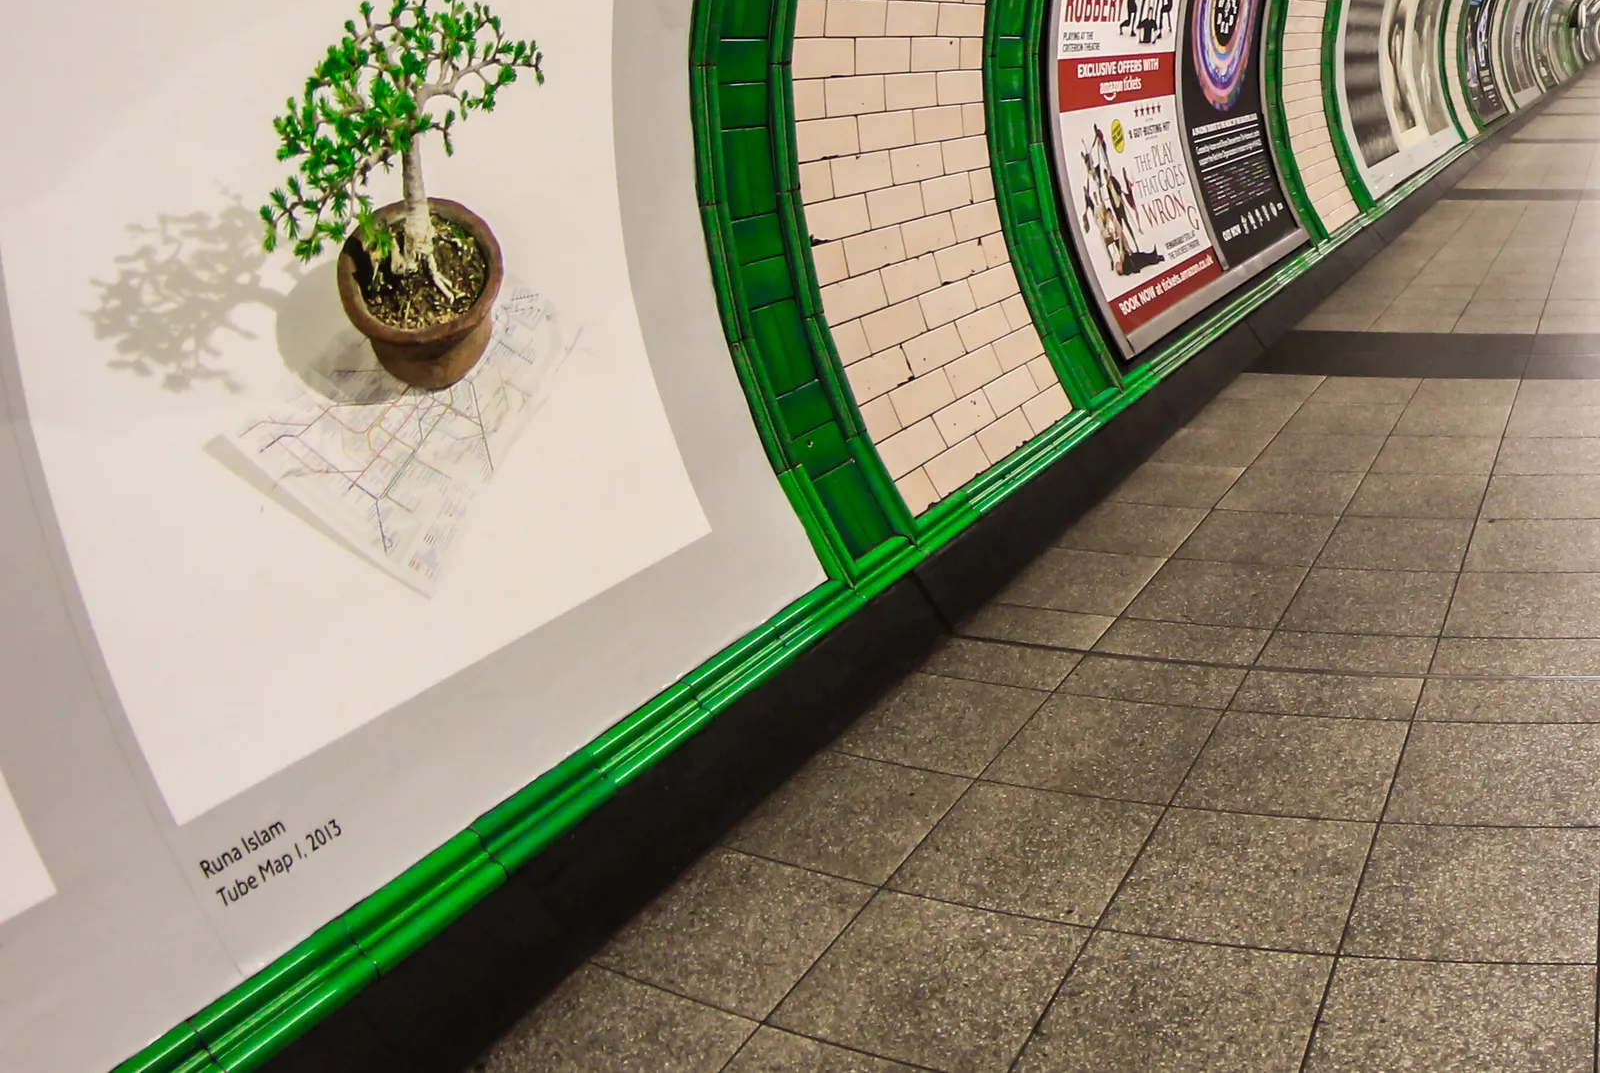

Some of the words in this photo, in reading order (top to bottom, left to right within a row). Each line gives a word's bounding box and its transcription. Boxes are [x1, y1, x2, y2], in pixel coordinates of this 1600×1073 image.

[1077, 62, 1117, 79] EXCLUSIVE
[1117, 59, 1142, 75] OFFERS
[1142, 57, 1160, 71] WITH
[1100, 79, 1123, 94] amazon
[1123, 75, 1142, 91] tickets
[1133, 123, 1163, 138] GUT-BUSTING
[1133, 154, 1152, 174] THE
[1151, 141, 1174, 168] PLAY
[1135, 175, 1159, 199] THAT
[1157, 164, 1186, 192] GOES
[1141, 190, 1200, 230] WRONG
[1118, 295, 1142, 316] BOOK
[1138, 286, 1157, 305] NOW
[1155, 283, 1164, 296] at
[1161, 254, 1214, 292] tickets.amazon.co.uk
[199, 847, 243, 879] Runa
[241, 821, 287, 854] Islam
[216, 875, 259, 907] Tube
[258, 853, 293, 883] Map
[305, 818, 342, 852] 2013
